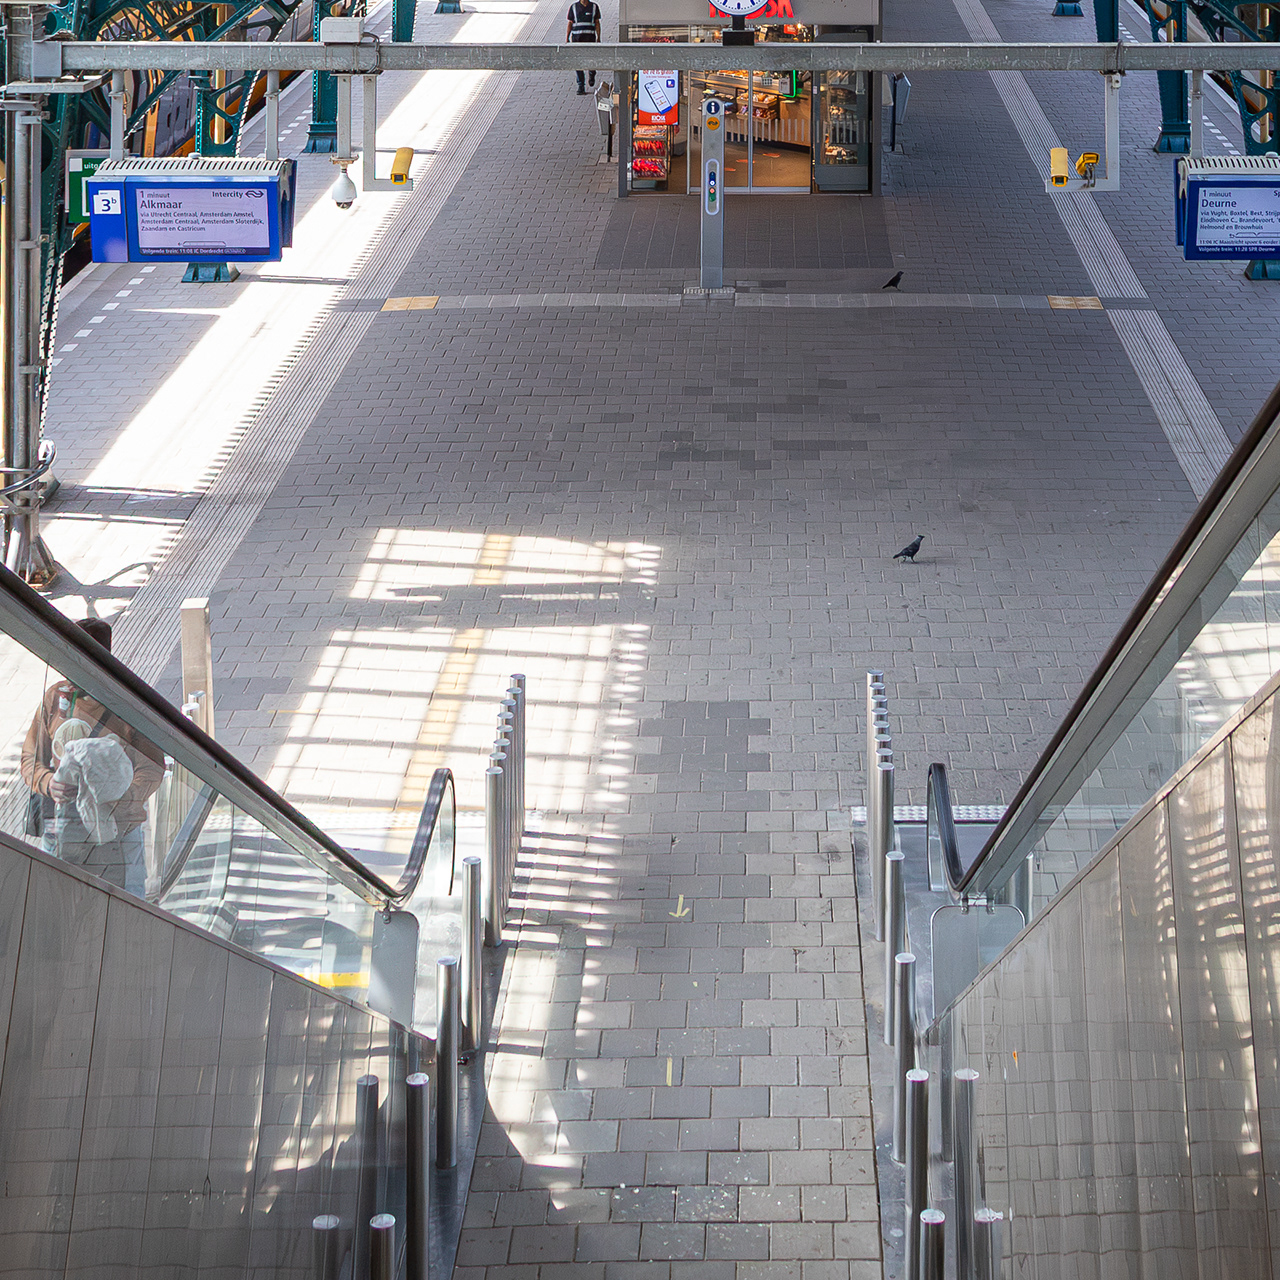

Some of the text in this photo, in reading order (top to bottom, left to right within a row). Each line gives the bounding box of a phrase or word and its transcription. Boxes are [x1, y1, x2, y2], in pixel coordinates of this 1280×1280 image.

[212, 190, 243, 199] Intercity
[140, 200, 182, 209] Alkmaar
[1201, 199, 1237, 207] Deurne
